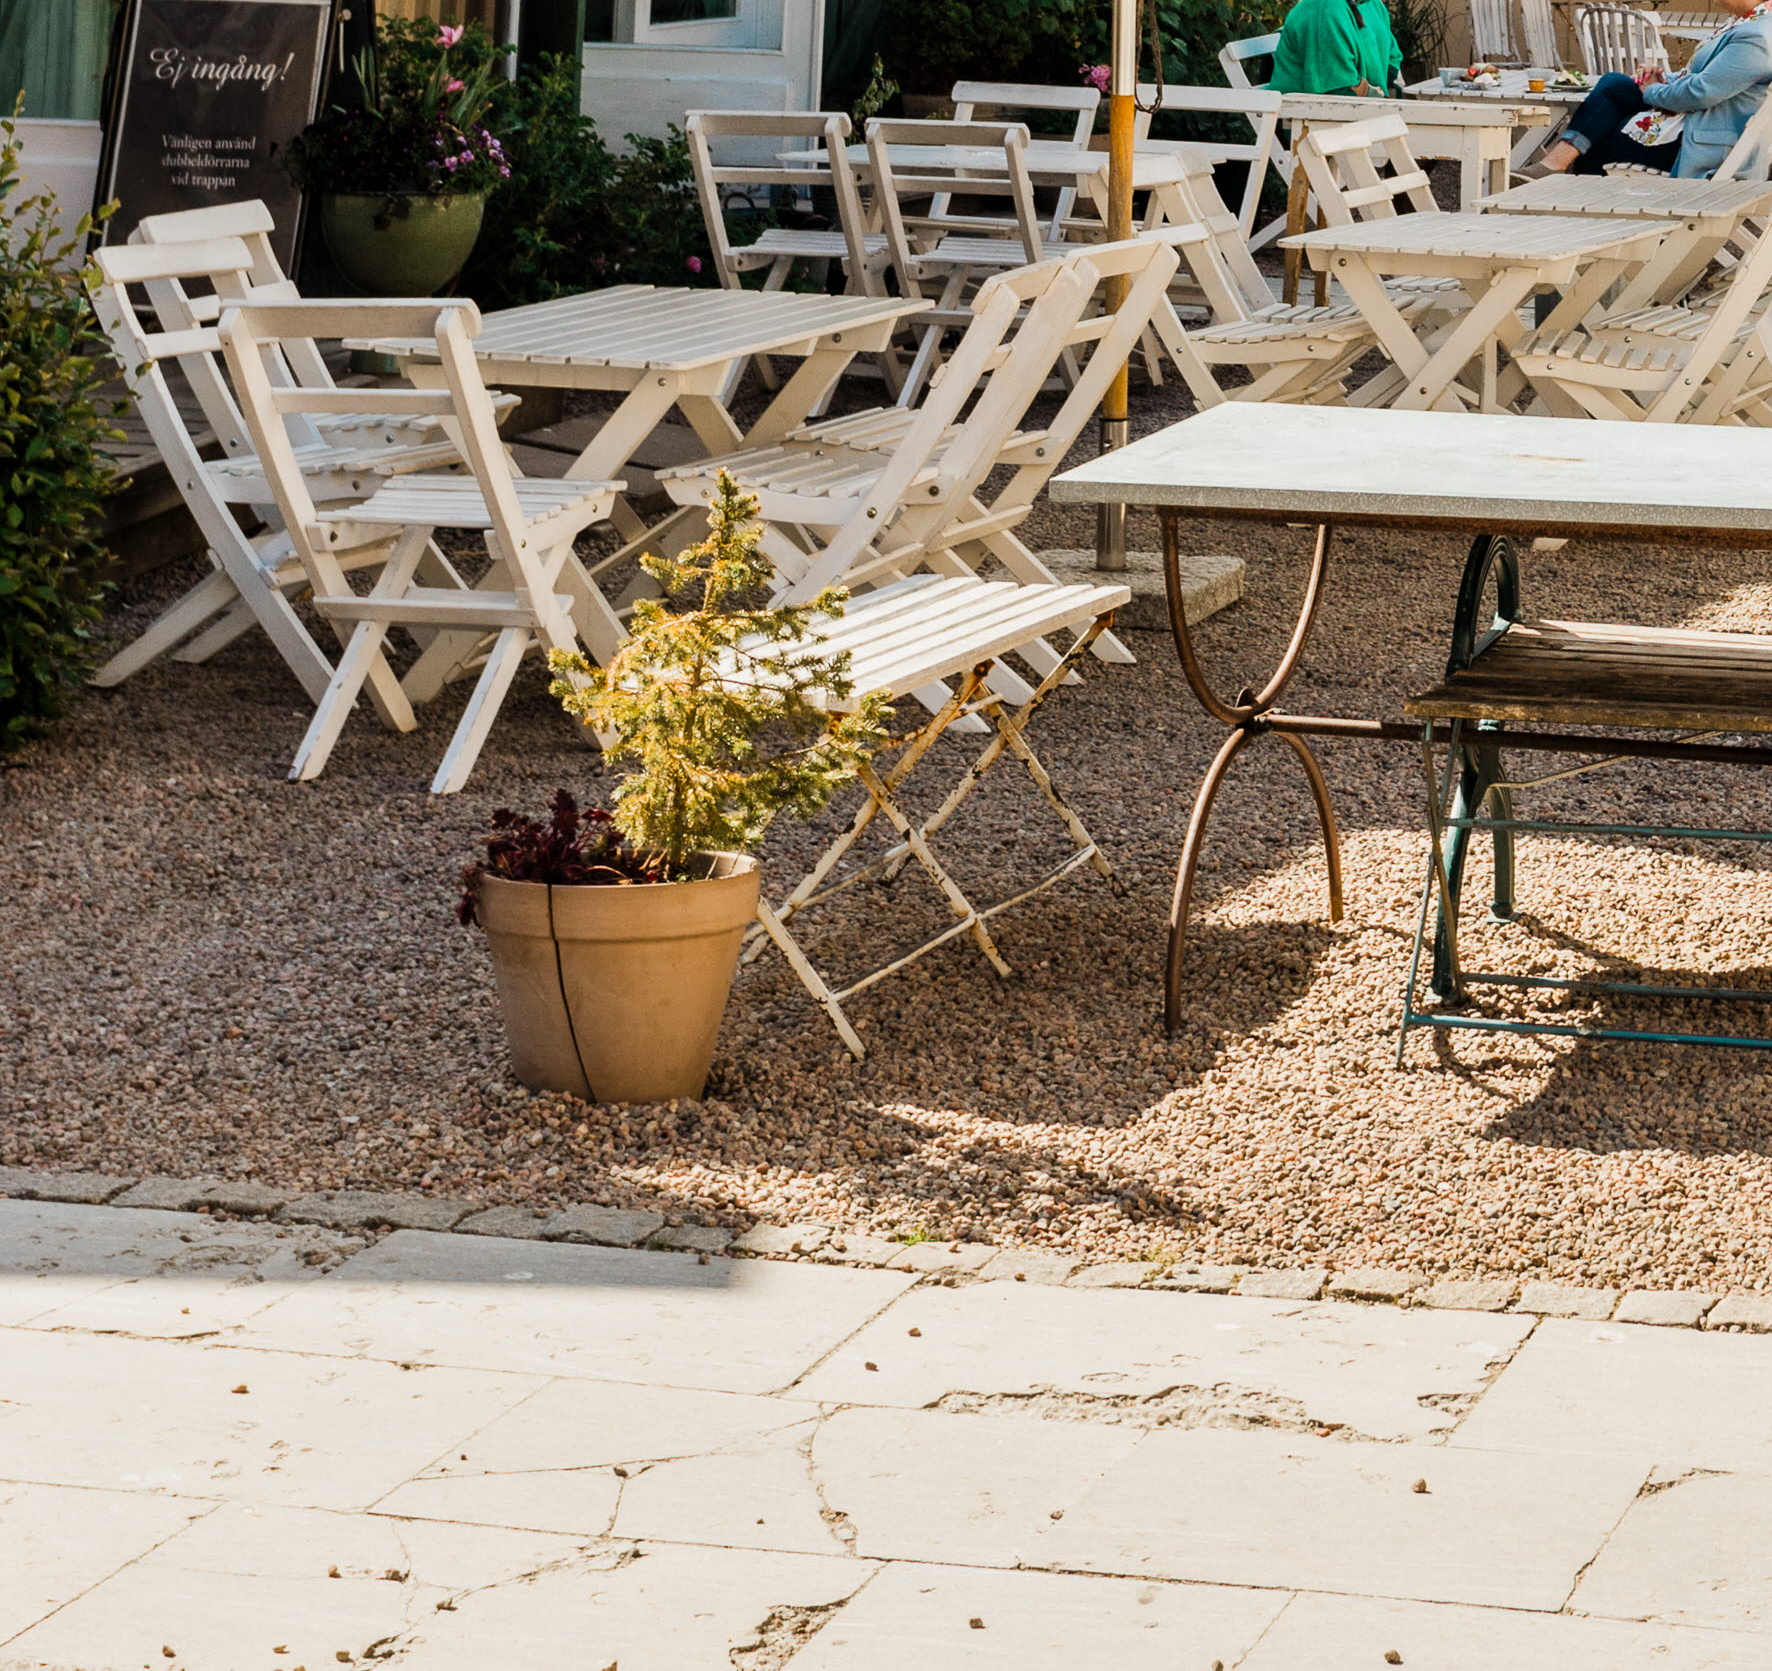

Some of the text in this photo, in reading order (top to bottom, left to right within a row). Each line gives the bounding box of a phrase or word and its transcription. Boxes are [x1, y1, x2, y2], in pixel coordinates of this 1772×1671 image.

[150, 47, 295, 91] Ej ingång!
[162, 134, 256, 153] Vänligen använd
[162, 153, 250, 168] dubbeldörrarna
[171, 171, 236, 190] vid trappan
